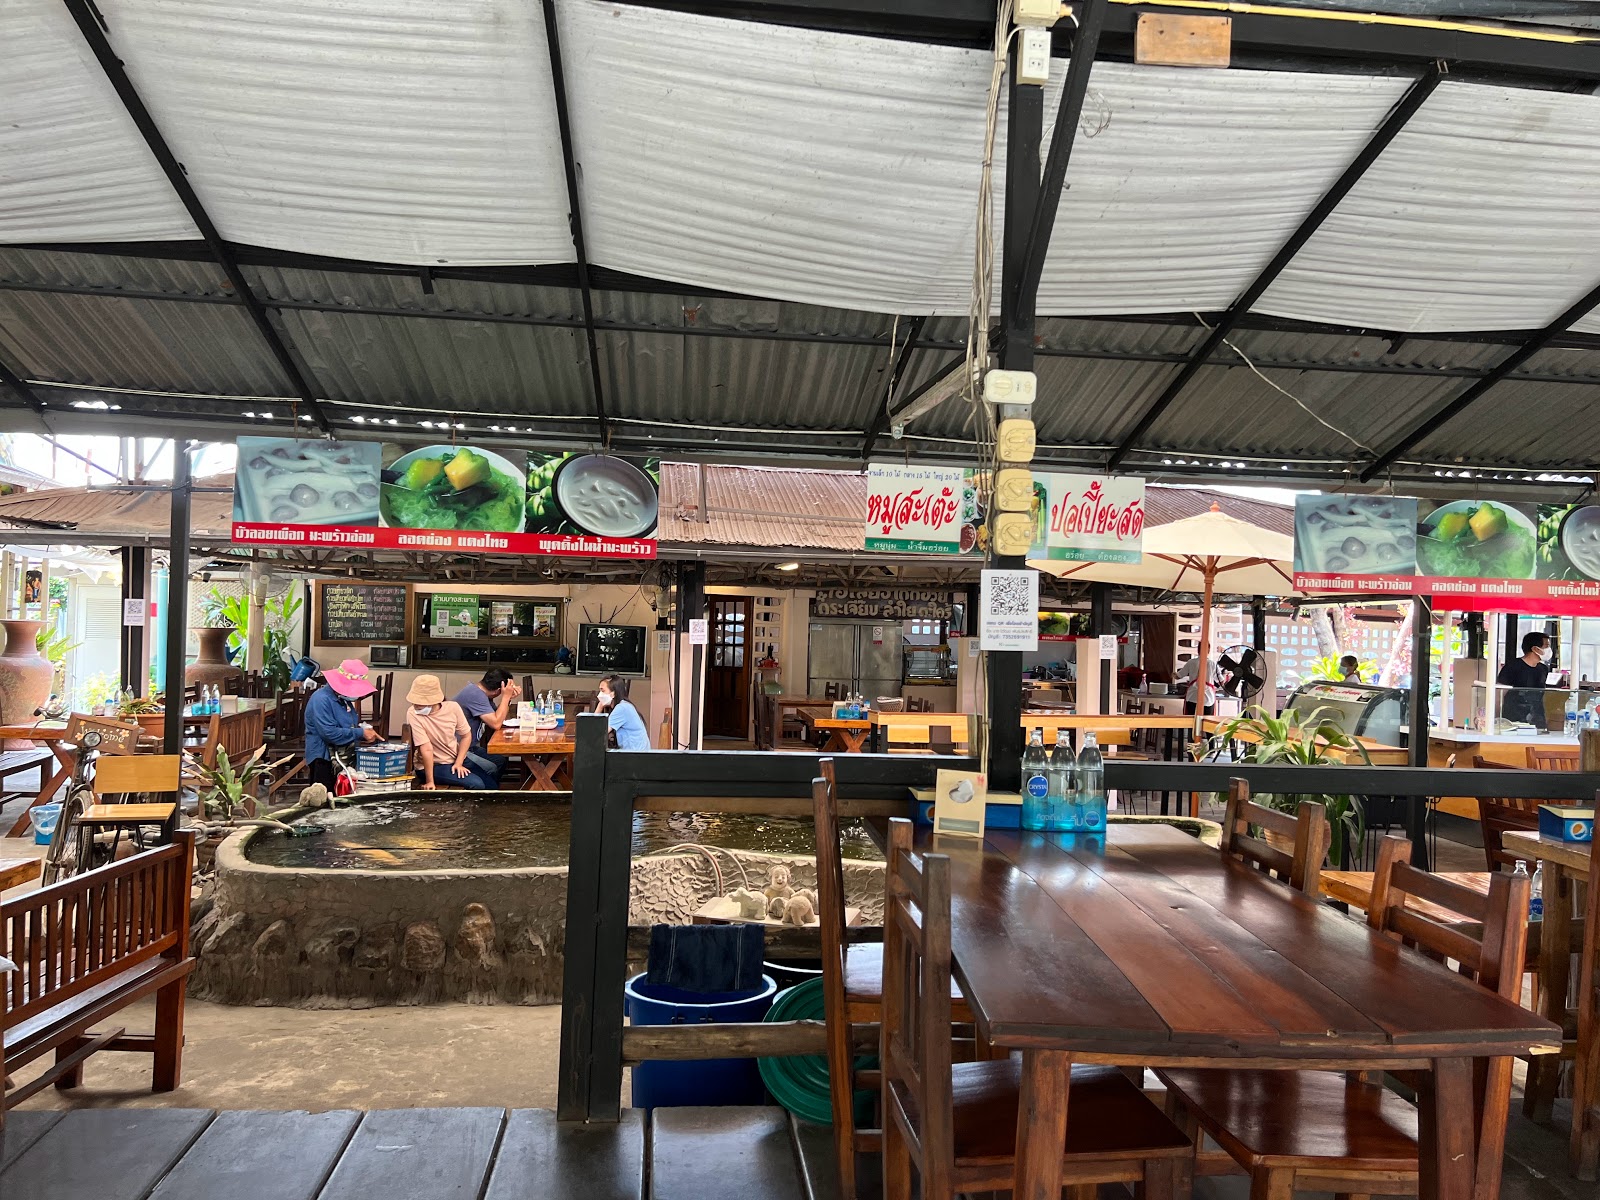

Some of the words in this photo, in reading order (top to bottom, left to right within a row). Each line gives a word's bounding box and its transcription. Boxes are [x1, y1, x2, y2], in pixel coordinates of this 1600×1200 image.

[235, 526, 305, 541] บัวลอยเผือก
[309, 528, 374, 544] มะพร้าวอ่อน
[398, 532, 453, 547] ลอดช่อง
[1065, 550, 1085, 560] อร่อย
[1296, 575, 1354, 589] บัวลอยเผือก
[1358, 577, 1412, 591] มะพร้าวอ่อน
[1431, 580, 1477, 593] ลอดช่อง
